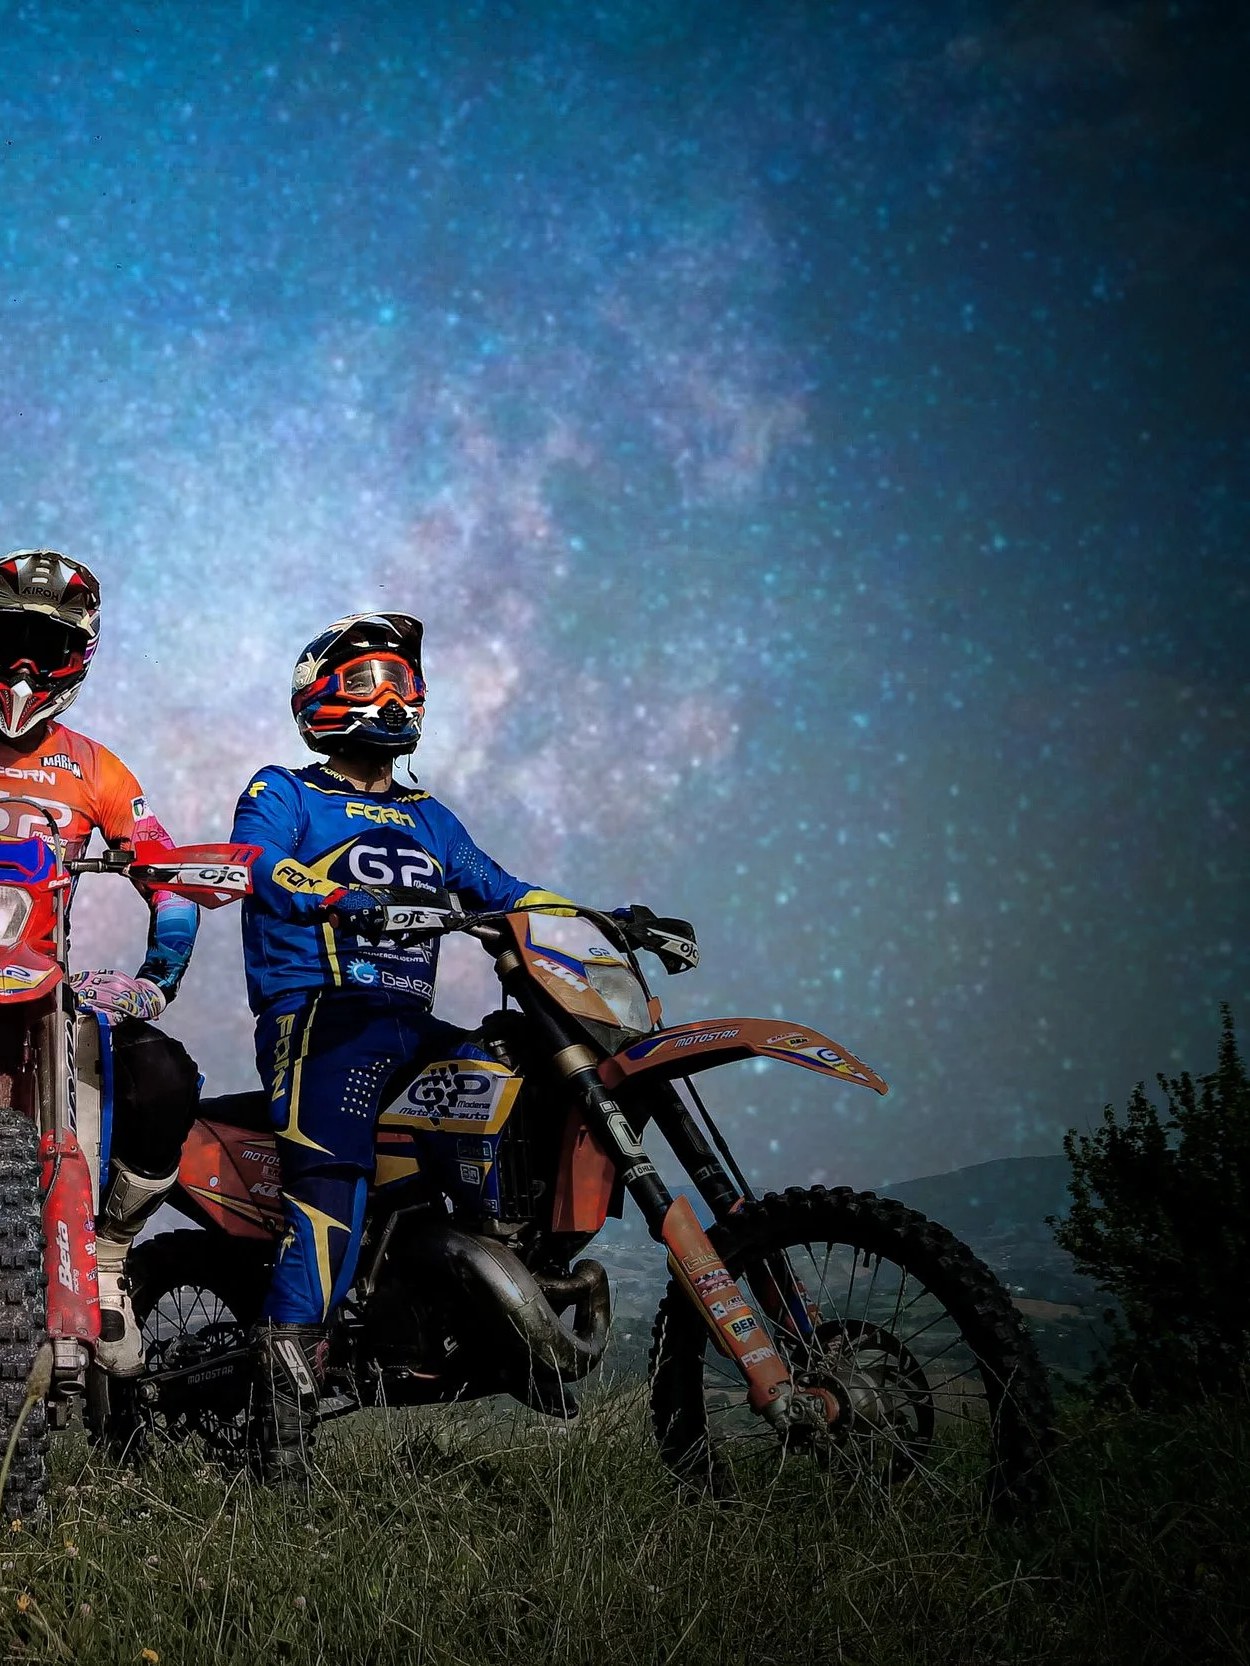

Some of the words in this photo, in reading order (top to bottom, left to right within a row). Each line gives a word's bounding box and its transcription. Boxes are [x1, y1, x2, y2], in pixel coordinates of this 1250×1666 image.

[319, 766, 346, 782] FORN
[346, 801, 416, 828] FORN
[198, 866, 245, 885] ojc
[349, 844, 434, 888] GP
[674, 1029, 740, 1048] MOTOSTAR
[56, 1220, 74, 1292] Beta
[731, 1317, 757, 1334] BER
[187, 1365, 234, 1385] MOTOSTAR
